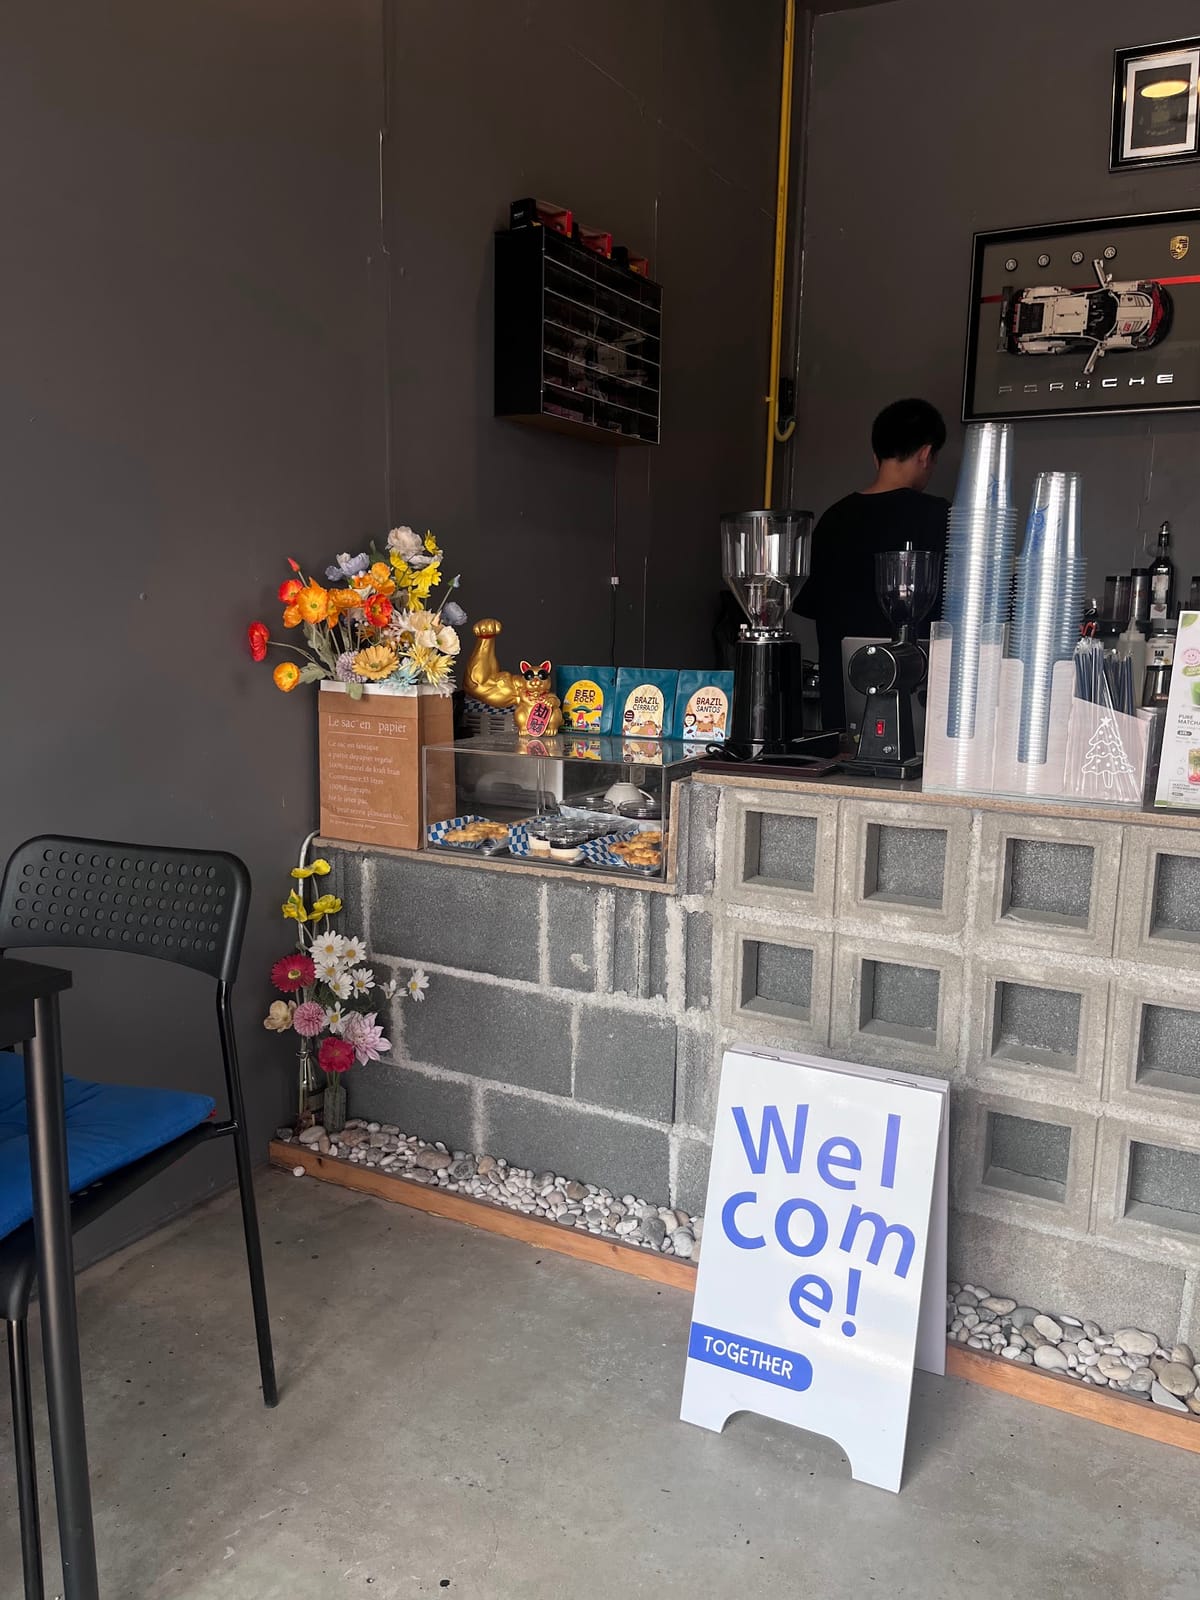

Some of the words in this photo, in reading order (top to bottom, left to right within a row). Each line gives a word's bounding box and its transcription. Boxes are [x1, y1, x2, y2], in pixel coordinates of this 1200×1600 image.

[575, 689, 596, 697] BED
[634, 696, 660, 705] BRAZIL
[633, 703, 659, 712] CERRADO
[696, 697, 723, 706] BRAZIL
[696, 705, 722, 714] SANTOS
[328, 714, 340, 727] Le
[341, 719, 356, 729] sac
[360, 721, 371, 730] en
[378, 721, 407, 736] papier
[731, 1104, 901, 1190] Wel
[721, 1191, 916, 1279] com
[788, 1268, 862, 1338] e!
[703, 1335, 793, 1380] TOGETHER
